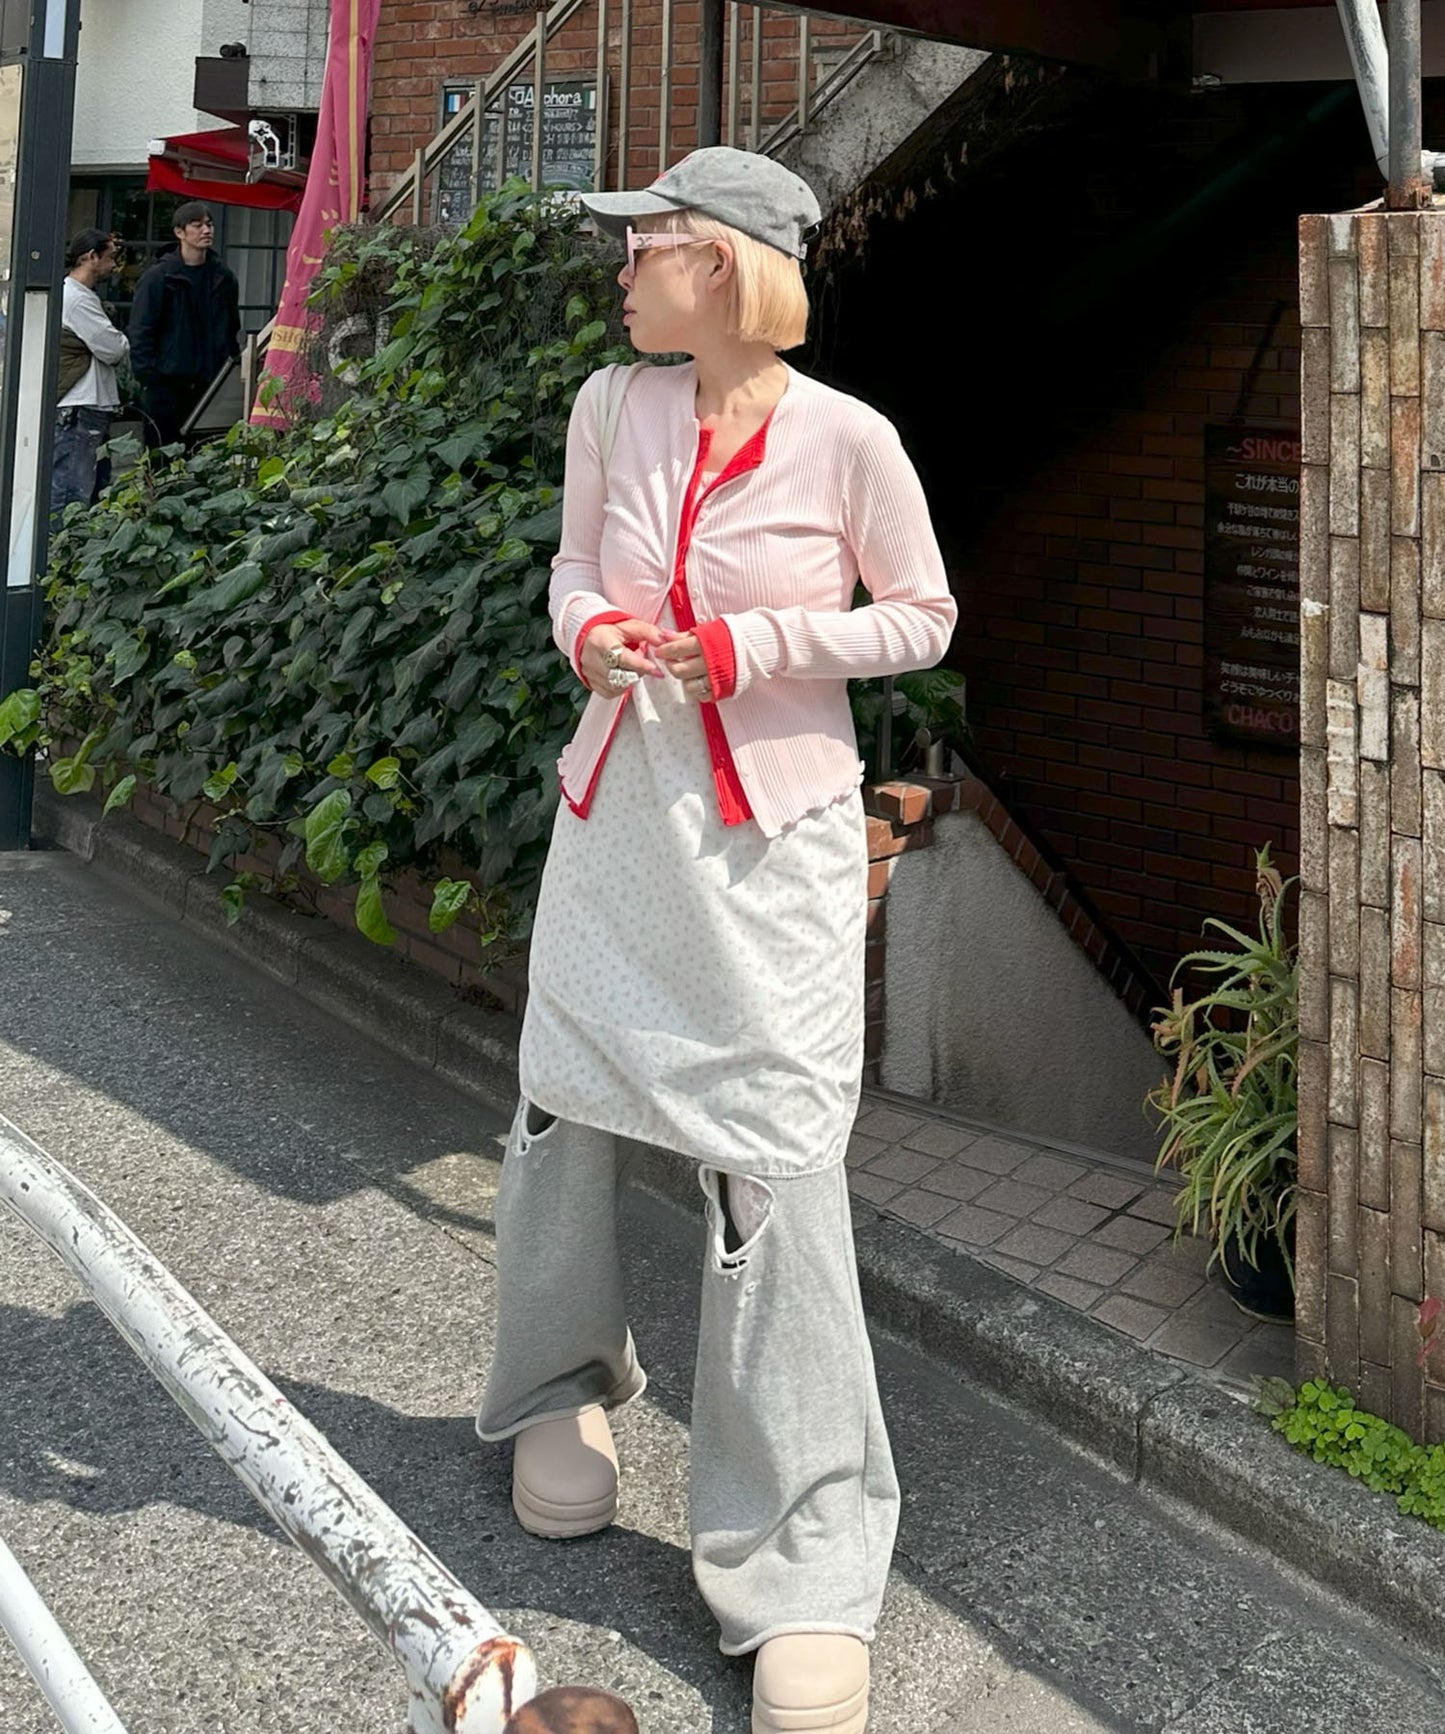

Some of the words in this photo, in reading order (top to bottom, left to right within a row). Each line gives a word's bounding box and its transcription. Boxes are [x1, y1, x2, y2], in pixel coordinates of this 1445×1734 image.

[524, 85, 582, 108] Aphora
[1235, 473, 1299, 494] これが本当の
[1227, 703, 1294, 733] CHACO
